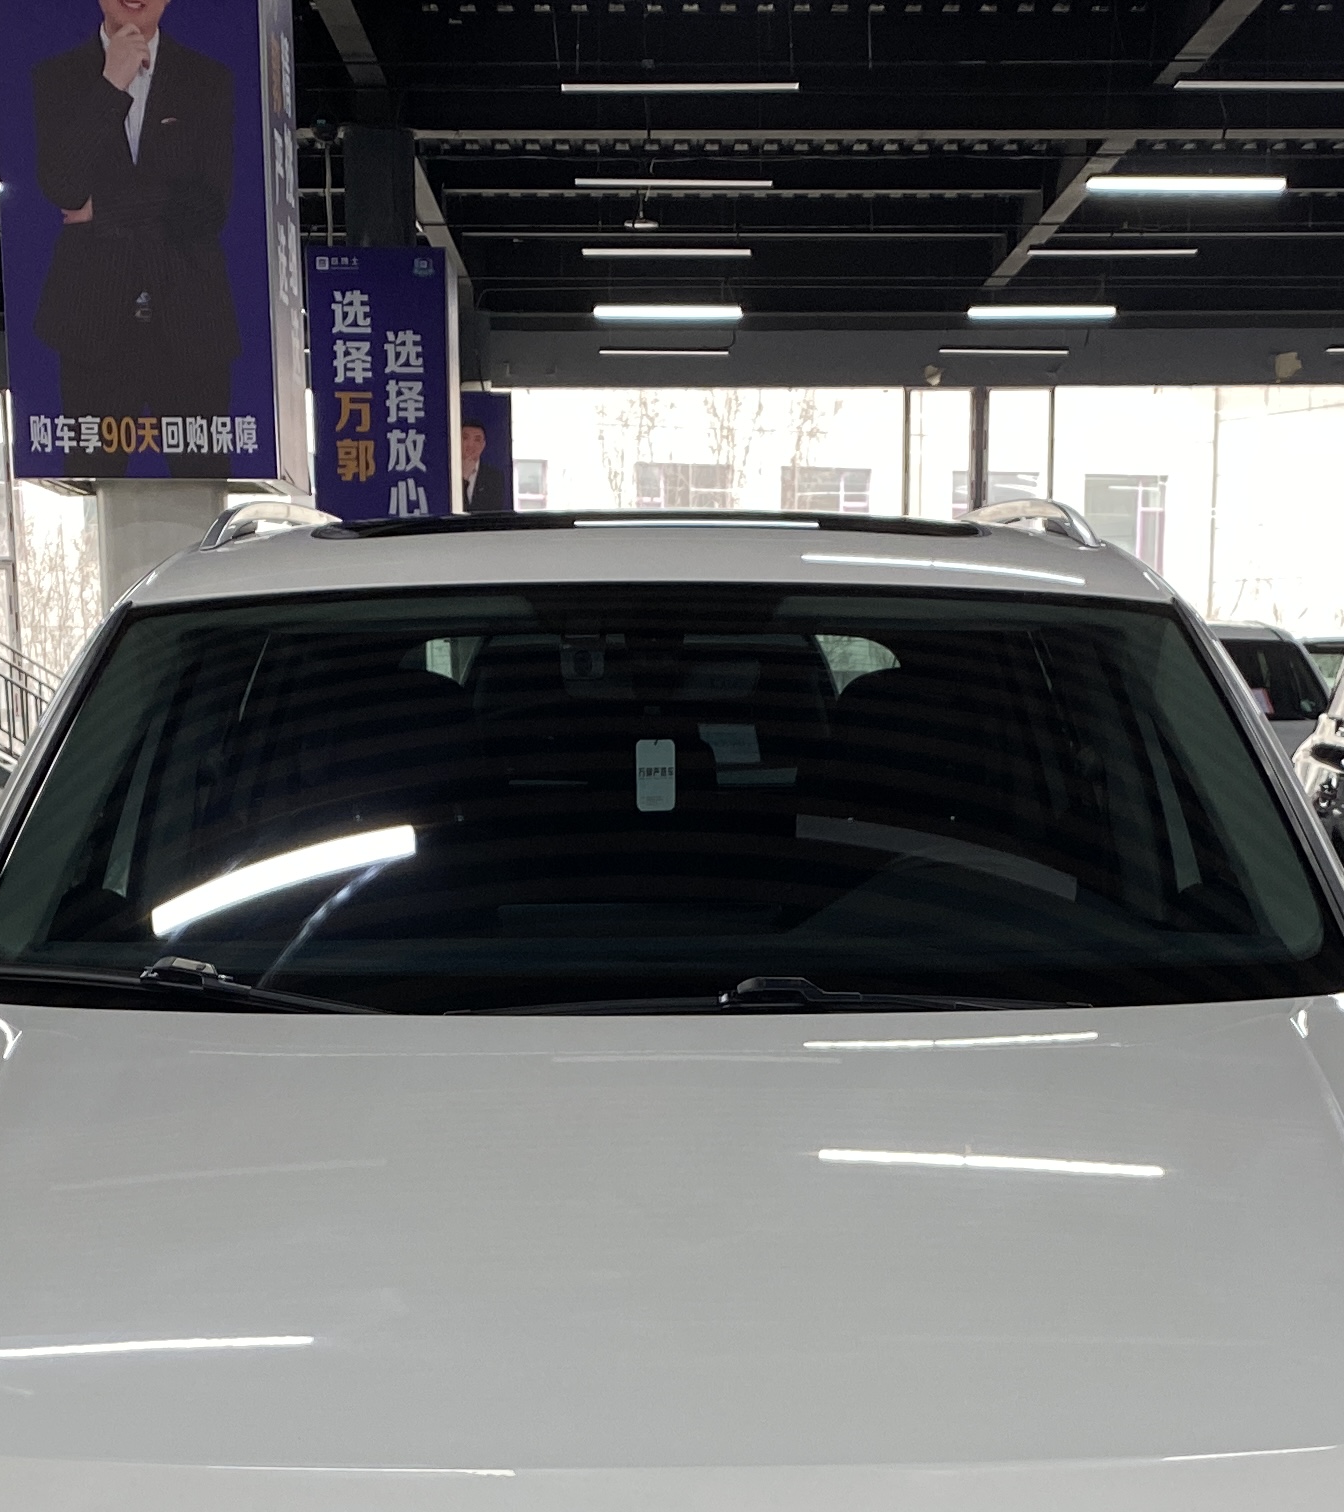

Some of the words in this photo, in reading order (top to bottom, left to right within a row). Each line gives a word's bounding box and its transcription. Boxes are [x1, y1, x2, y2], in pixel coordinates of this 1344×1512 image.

[29, 415, 258, 454] 购车享90天回购保障
[331, 290, 376, 482] 选择万郭
[384, 330, 430, 517] 选择放心
